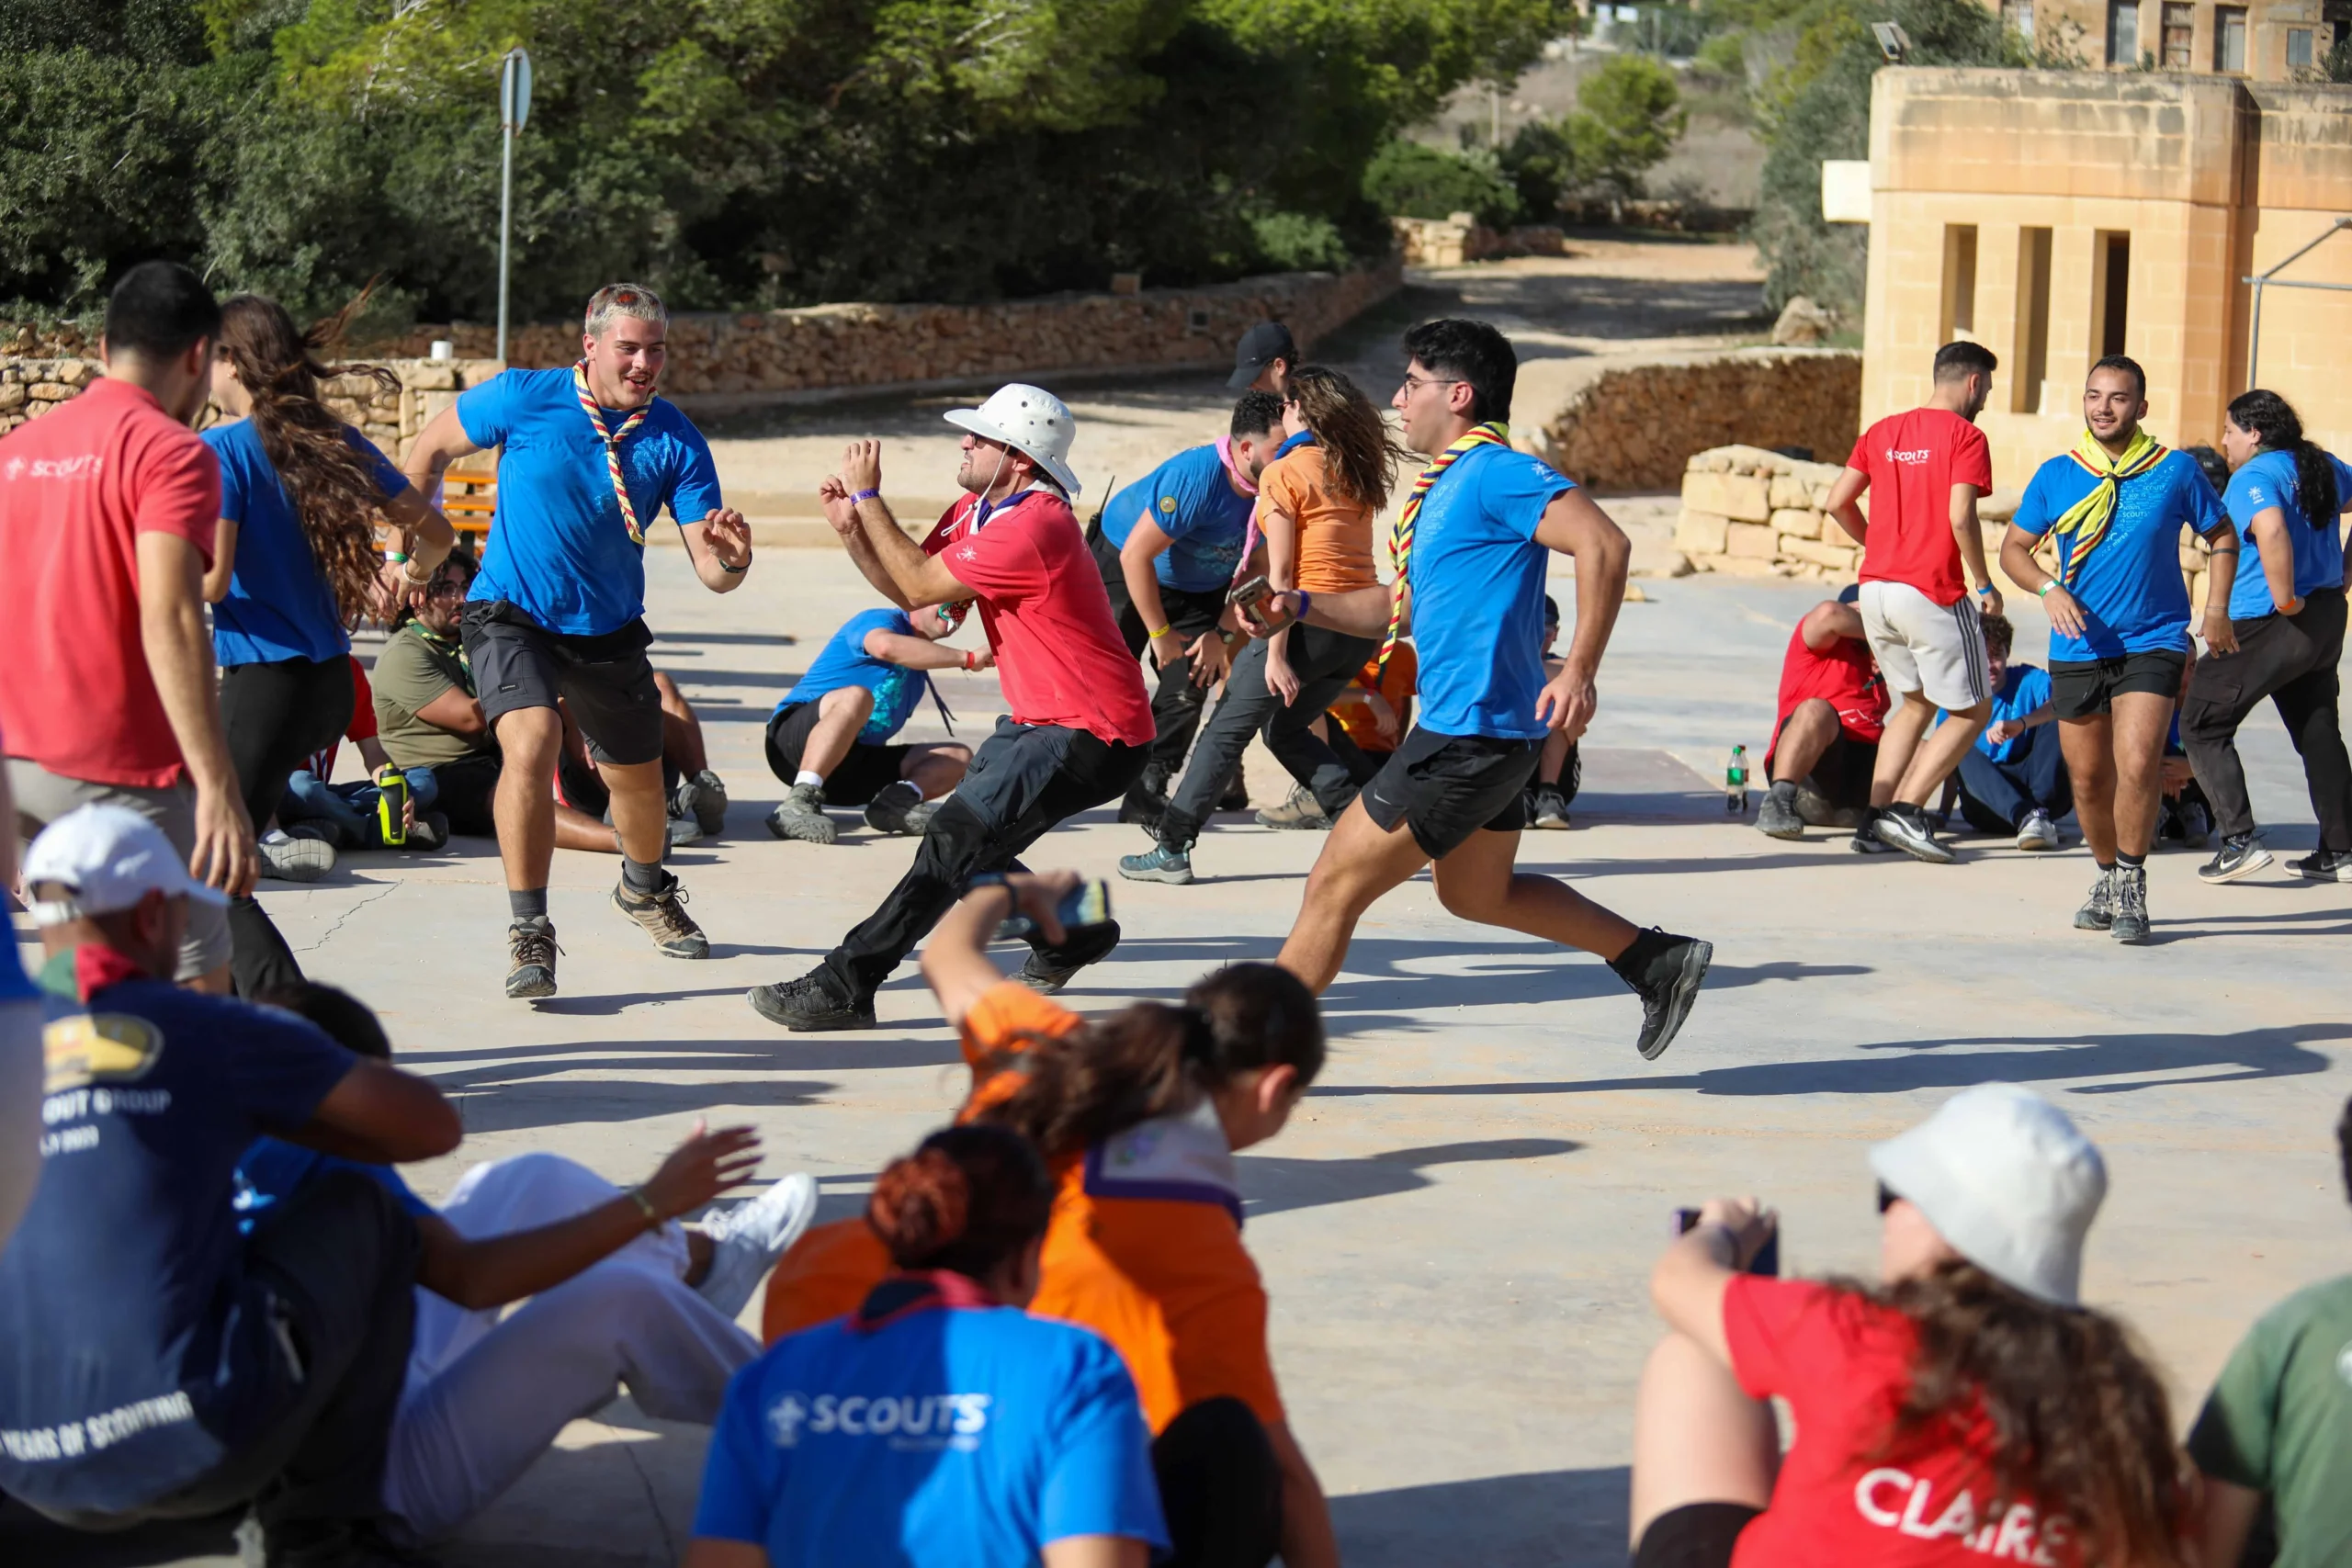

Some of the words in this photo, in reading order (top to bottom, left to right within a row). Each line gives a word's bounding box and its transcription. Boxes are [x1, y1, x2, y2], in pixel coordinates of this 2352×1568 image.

[29, 455, 102, 478] SCOUTS
[1, 1427, 62, 1461] YEARS
[59, 1421, 86, 1457] OF
[85, 1390, 194, 1450] SCOUTING
[808, 1393, 989, 1435] SCOUTS
